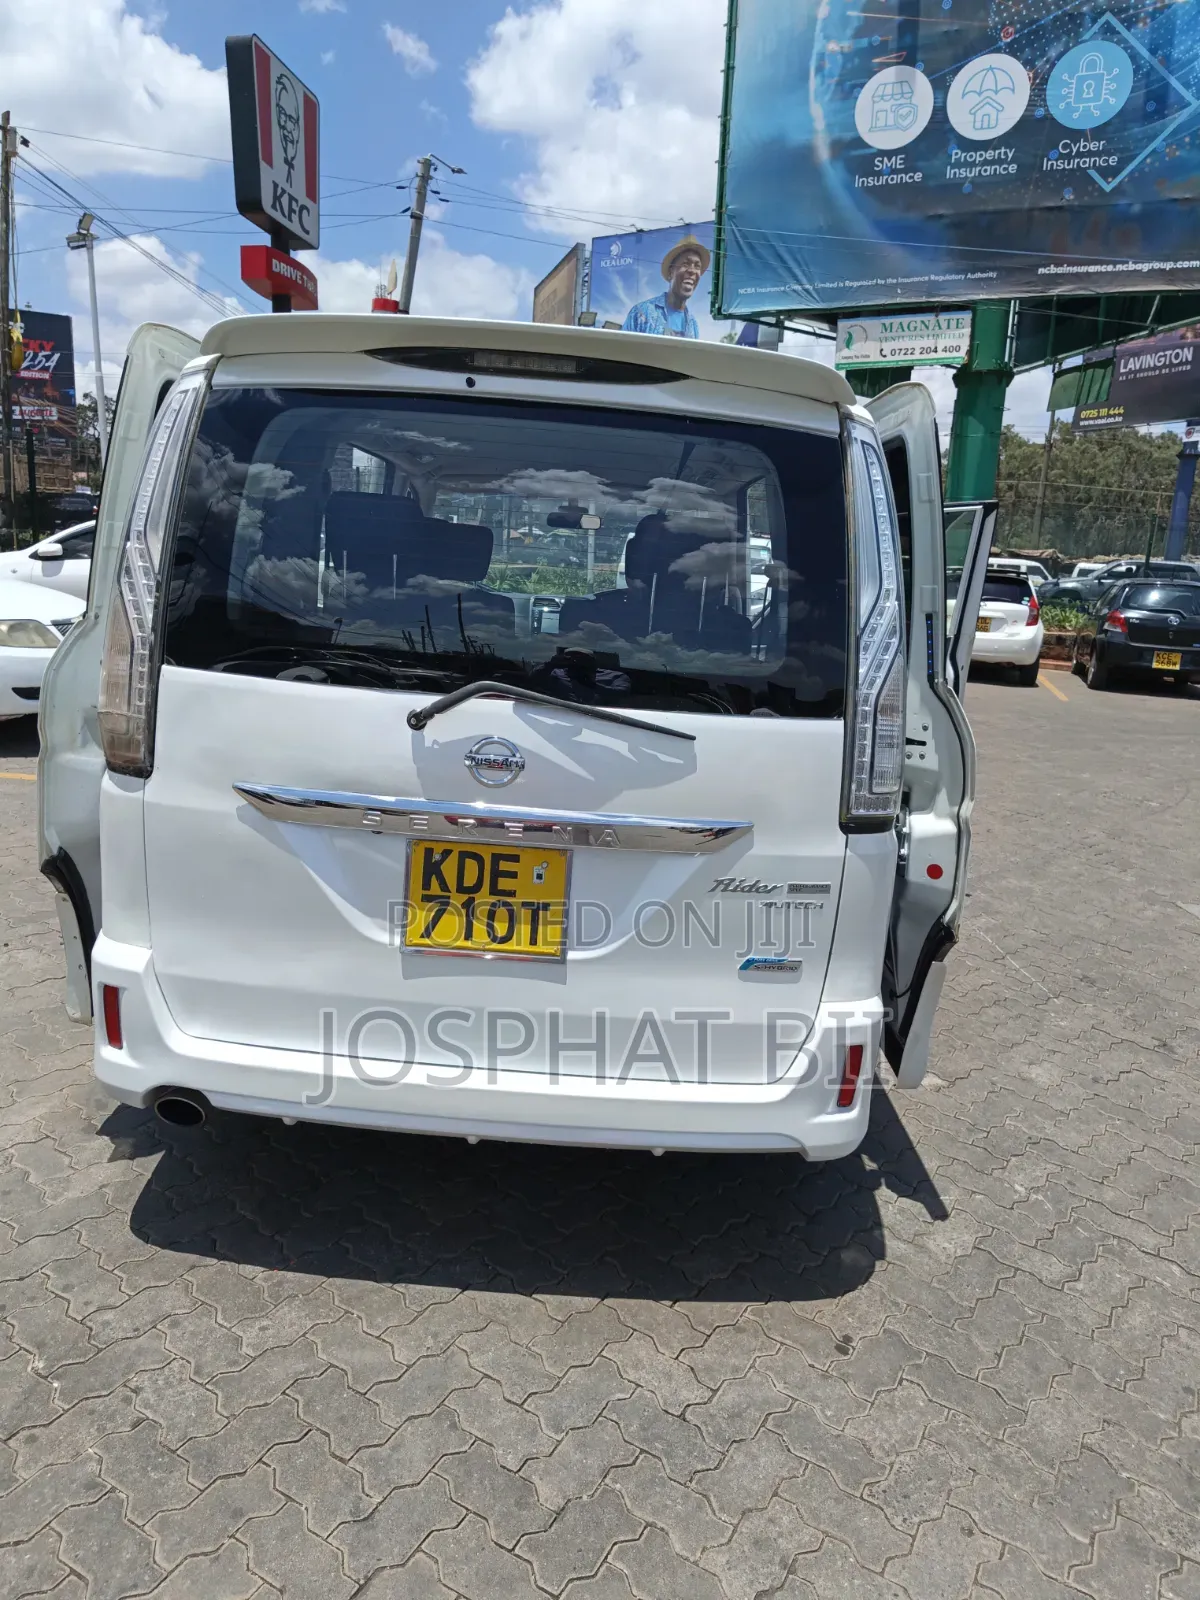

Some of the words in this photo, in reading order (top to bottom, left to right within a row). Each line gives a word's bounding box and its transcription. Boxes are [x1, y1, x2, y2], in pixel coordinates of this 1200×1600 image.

[951, 146, 1015, 164] Property
[1058, 138, 1106, 156] Cyber
[874, 155, 905, 171] SME
[946, 162, 1018, 179] Insurance
[1042, 155, 1118, 171] Insurance
[854, 171, 923, 188] Insurance
[271, 180, 310, 236] KFC
[272, 258, 302, 285] DRIVE
[600, 259, 616, 268] ICEA
[617, 258, 633, 266] LION
[1037, 259, 1200, 275] ncbainsurance.ncbagroup.com
[738, 286, 756, 295] NCBA
[757, 284, 785, 294] Insurance
[814, 281, 838, 289] Limited
[877, 278, 885, 286] by
[886, 277, 897, 285] the
[898, 275, 929, 283] Insurance
[930, 273, 966, 282] Regulatory
[966, 270, 998, 279] Authority
[880, 317, 965, 334] MAGNATE
[879, 333, 923, 344] VENTURES
[925, 331, 965, 342] LIMITED
[890, 347, 916, 356] 0722
[919, 346, 938, 355] 204
[941, 344, 961, 353] 400
[21, 349, 61, 373] 254
[1119, 346, 1194, 373] LAVINGTON
[20, 371, 50, 380] EDITION
[1136, 369, 1160, 378] SHOULD
[1171, 364, 1192, 373] LIVED
[1080, 409, 1098, 419] 0725
[1099, 408, 1108, 416] 111
[1109, 406, 1125, 415] 444
[1155, 652, 1173, 661] KCE
[1155, 660, 1178, 668] 568W
[470, 757, 520, 768] NISSAN
[362, 810, 621, 848] SERENA
[421, 847, 521, 898] KDE
[708, 877, 784, 894] Rider
[419, 893, 551, 946] 710T
